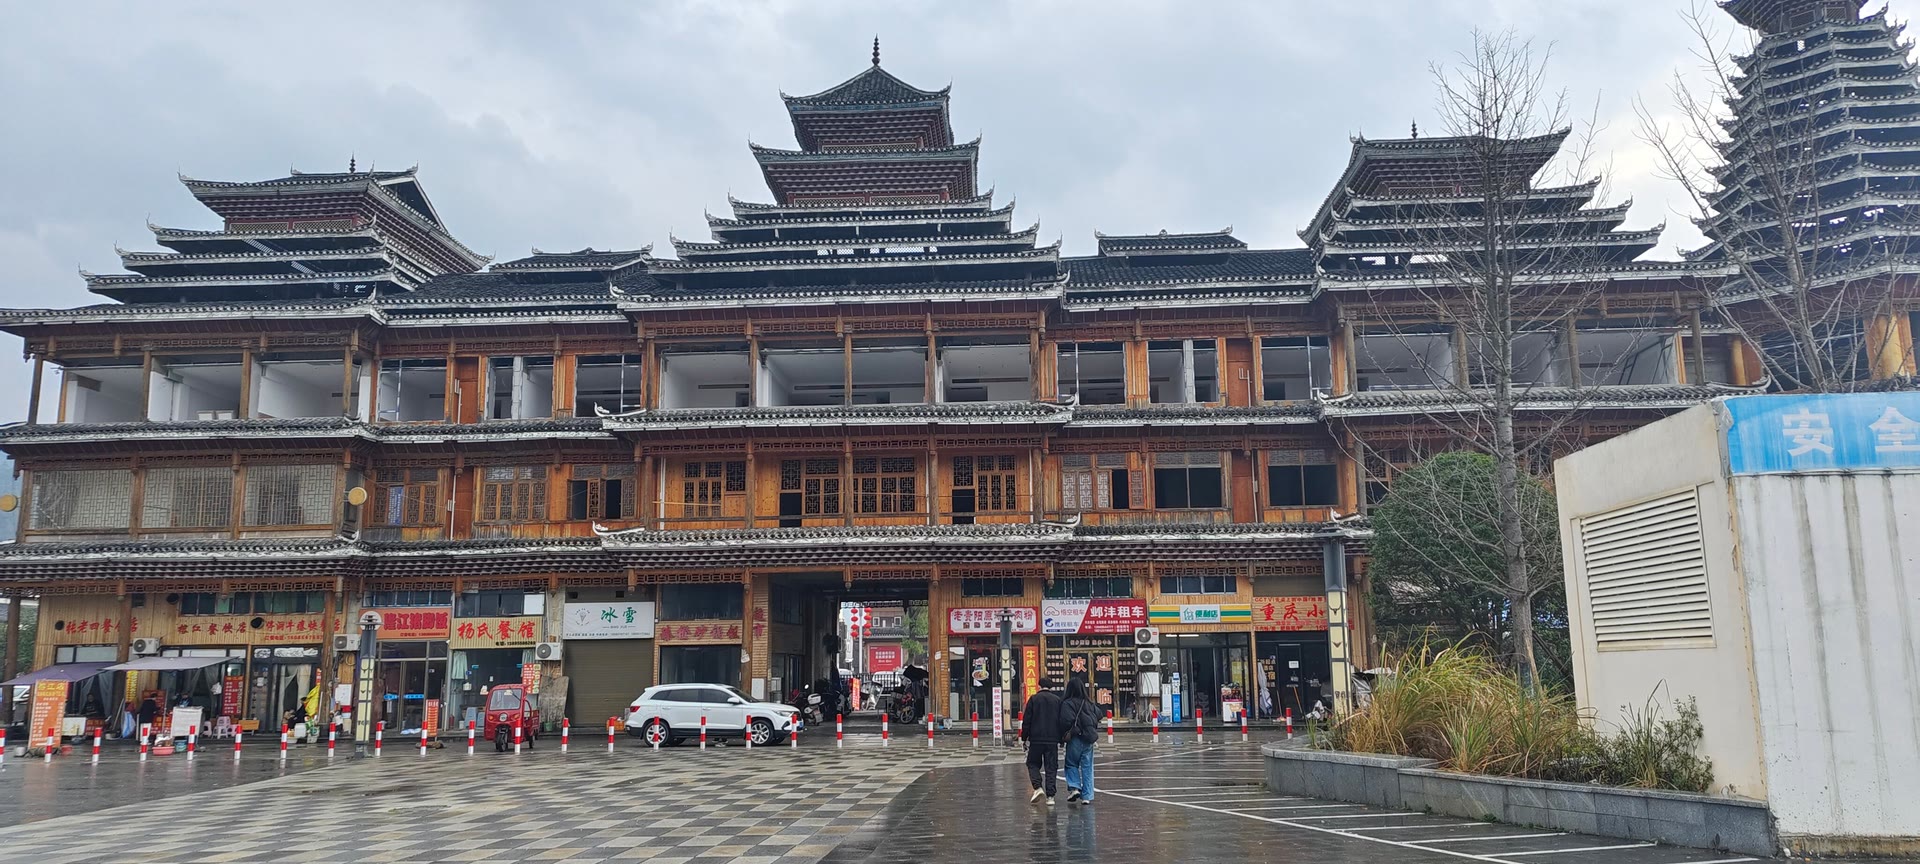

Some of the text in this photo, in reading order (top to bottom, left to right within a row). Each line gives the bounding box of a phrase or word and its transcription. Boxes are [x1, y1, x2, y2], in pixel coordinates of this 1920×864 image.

[1782, 407, 1920, 457] 安全
[601, 607, 637, 623] 冰雪
[953, 610, 1033, 621] 老贵阳原汤肉粉
[457, 621, 536, 640] 杨氏餐馆
